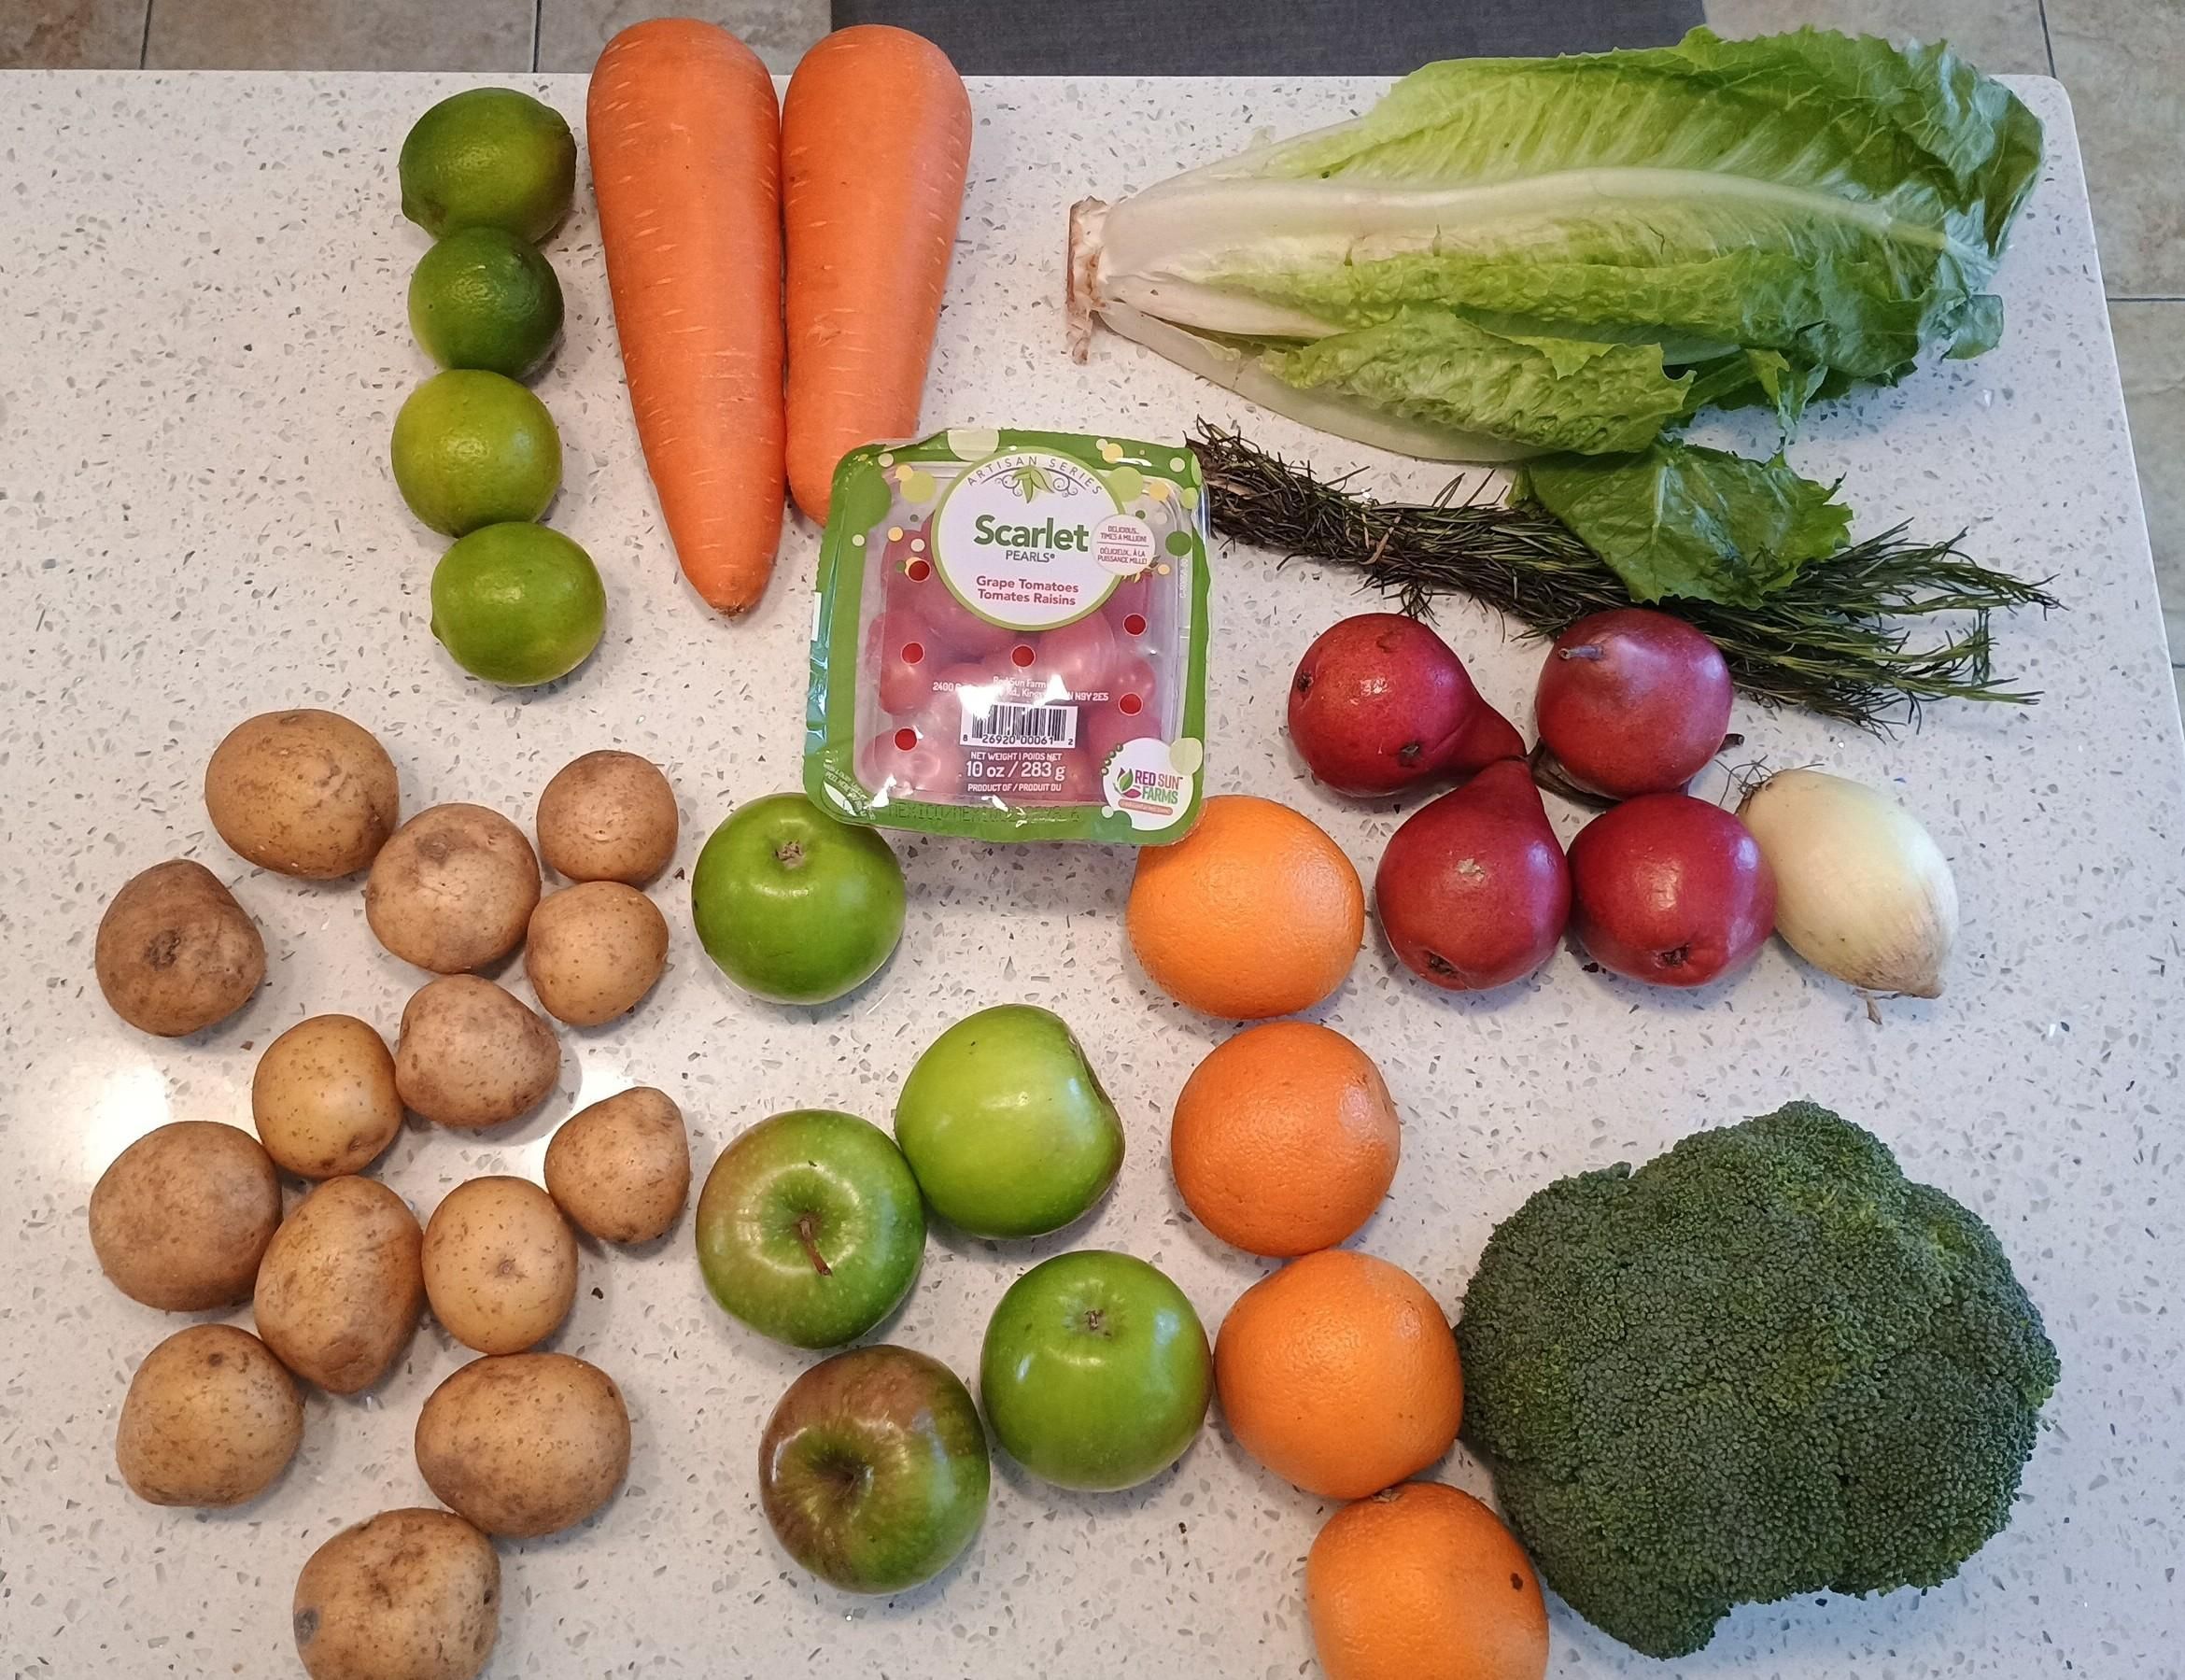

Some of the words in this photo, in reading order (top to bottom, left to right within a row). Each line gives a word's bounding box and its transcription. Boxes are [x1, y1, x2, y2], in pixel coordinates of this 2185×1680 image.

[966, 456, 1037, 486] ARTISAN
[1049, 459, 1103, 494] SERIES
[973, 514, 1090, 552] Scarlet
[1097, 555, 1129, 564] PUISSANCE
[976, 575, 1015, 590] Grape
[1019, 578, 1079, 593] Tomatoes
[978, 588, 1030, 602] Tomates
[1034, 593, 1077, 606] Raisins
[963, 734, 968, 742] 8
[981, 734, 1016, 744] 26920
[1020, 736, 1053, 745] 00061
[1067, 738, 1074, 746] 2
[970, 752, 986, 760] NET
[987, 752, 1018, 761] WEIGHT
[1022, 753, 1046, 761] POIDS
[1046, 753, 1063, 762] NET
[966, 760, 983, 778] 10
[986, 766, 1006, 778] oz
[1007, 760, 1019, 778] /
[1021, 761, 1052, 778] 283
[1054, 765, 1066, 782] g
[1135, 769, 1156, 786] RED
[967, 783, 1002, 792] PRODUCT
[1002, 784, 1012, 792] OF
[1019, 784, 1050, 792] PRODUIT
[1050, 784, 1062, 792] DU
[1142, 785, 1178, 805] FARMS
